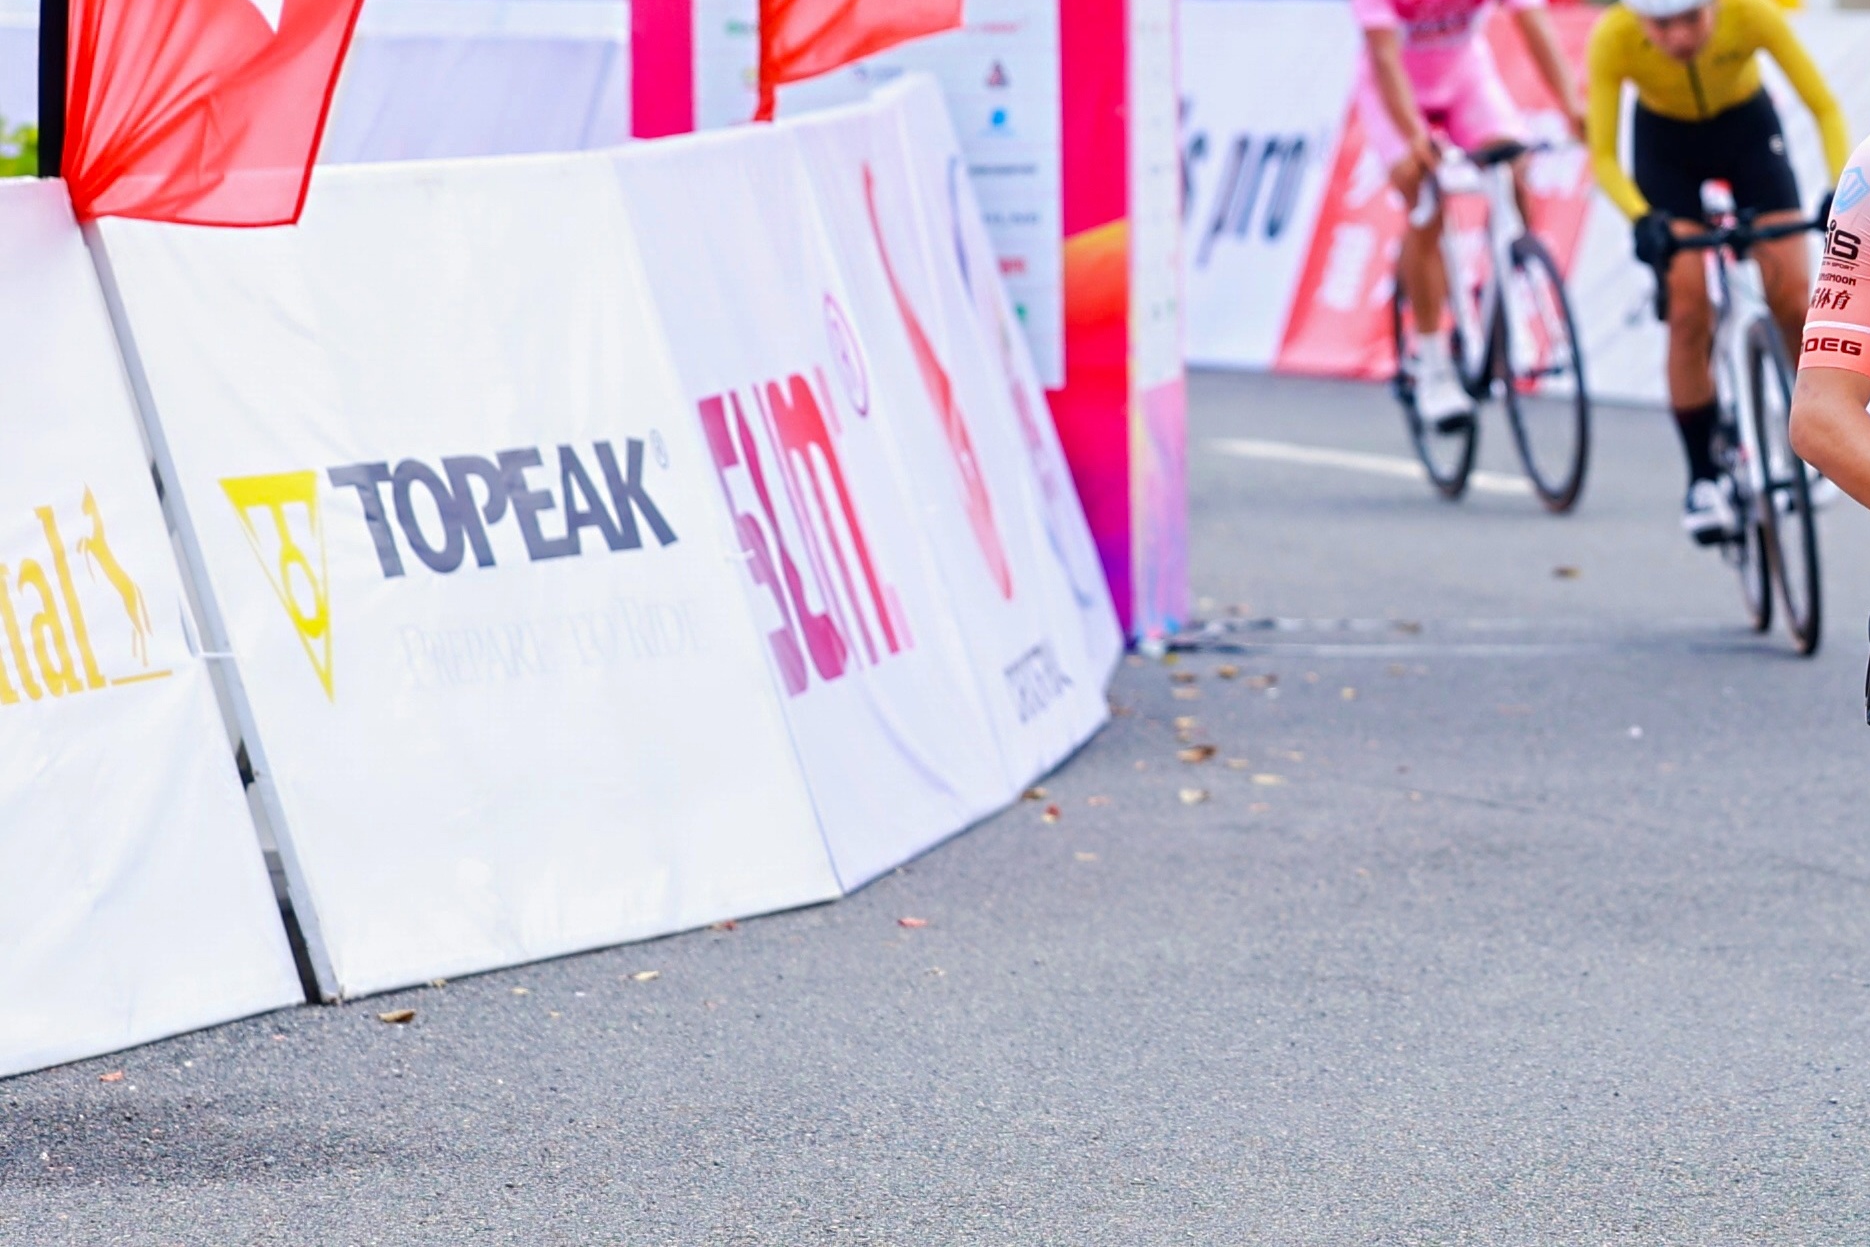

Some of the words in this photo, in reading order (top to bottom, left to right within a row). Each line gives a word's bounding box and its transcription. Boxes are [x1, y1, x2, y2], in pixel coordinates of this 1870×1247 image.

[1801, 337, 1863, 356] OEG
[326, 437, 679, 580] TOPEAK
[0, 505, 107, 704] tal
